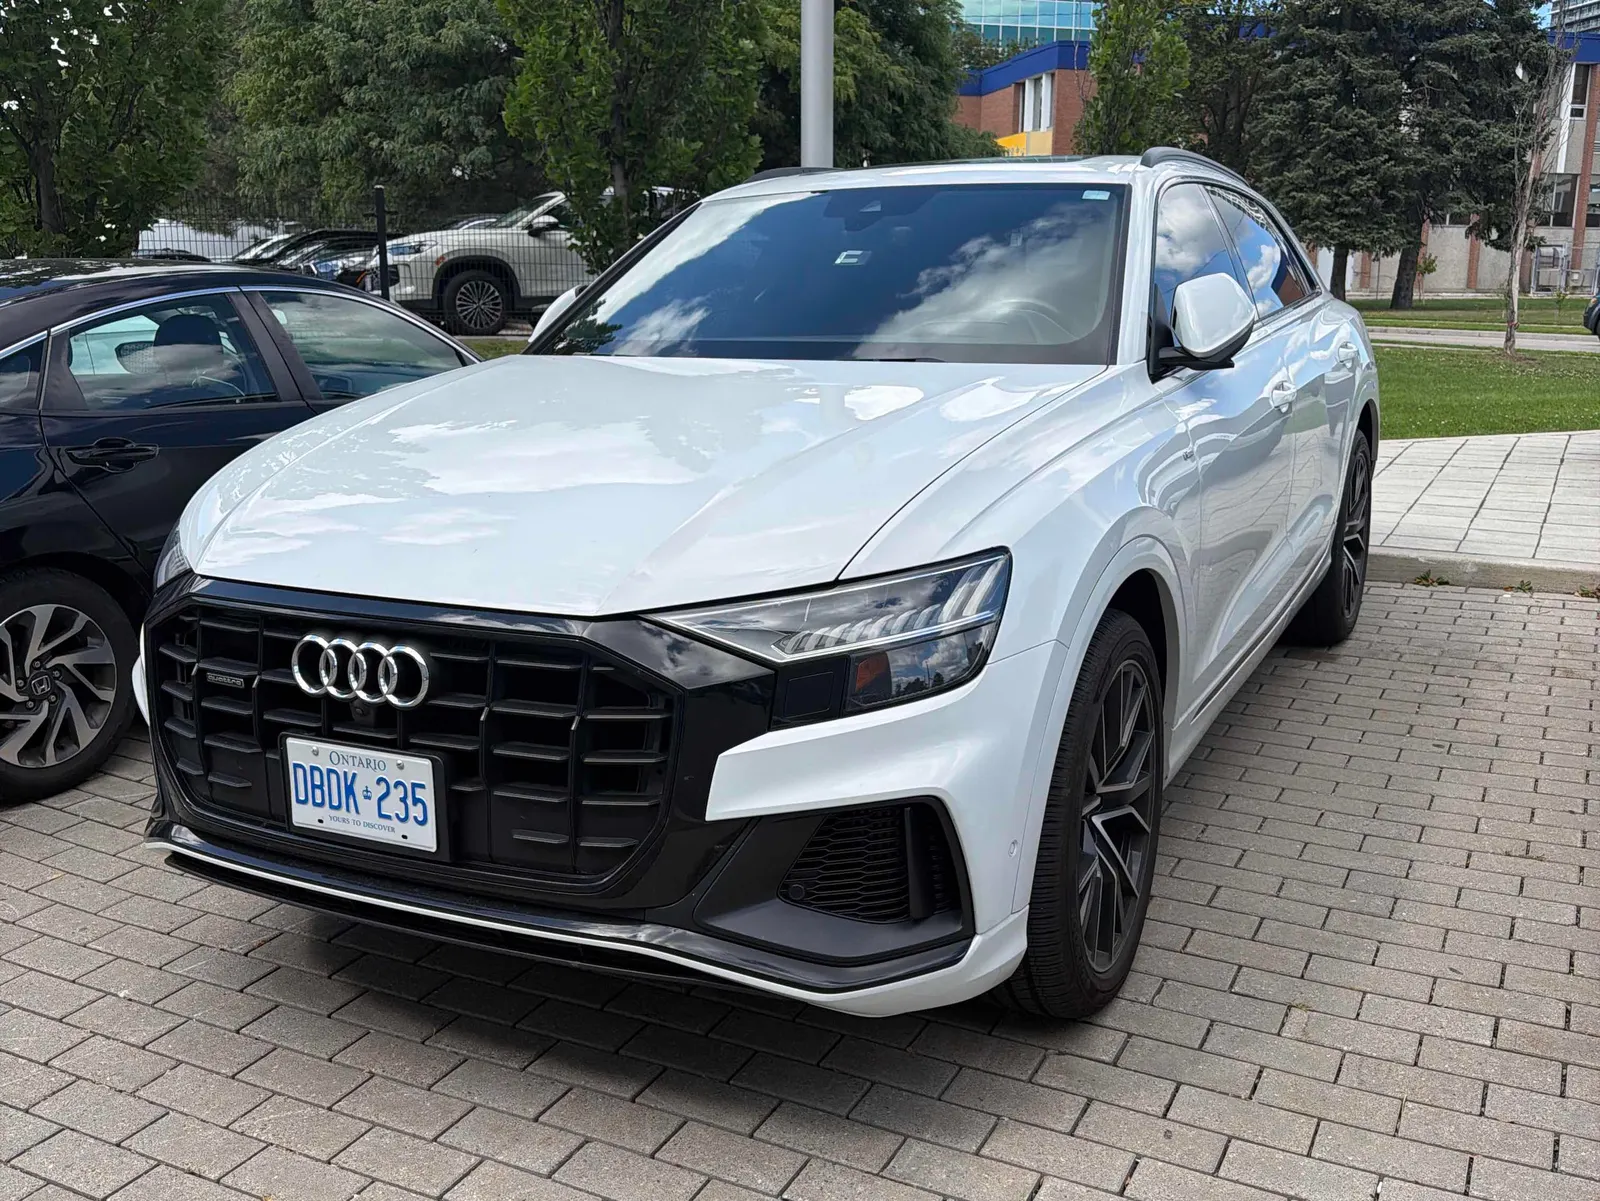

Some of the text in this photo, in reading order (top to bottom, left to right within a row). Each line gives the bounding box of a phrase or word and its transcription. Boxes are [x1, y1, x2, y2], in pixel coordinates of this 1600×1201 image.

[329, 750, 387, 773] ONTARIO
[292, 762, 428, 827] DBDK 235
[328, 814, 396, 834] YOURS TO DISCOVER
